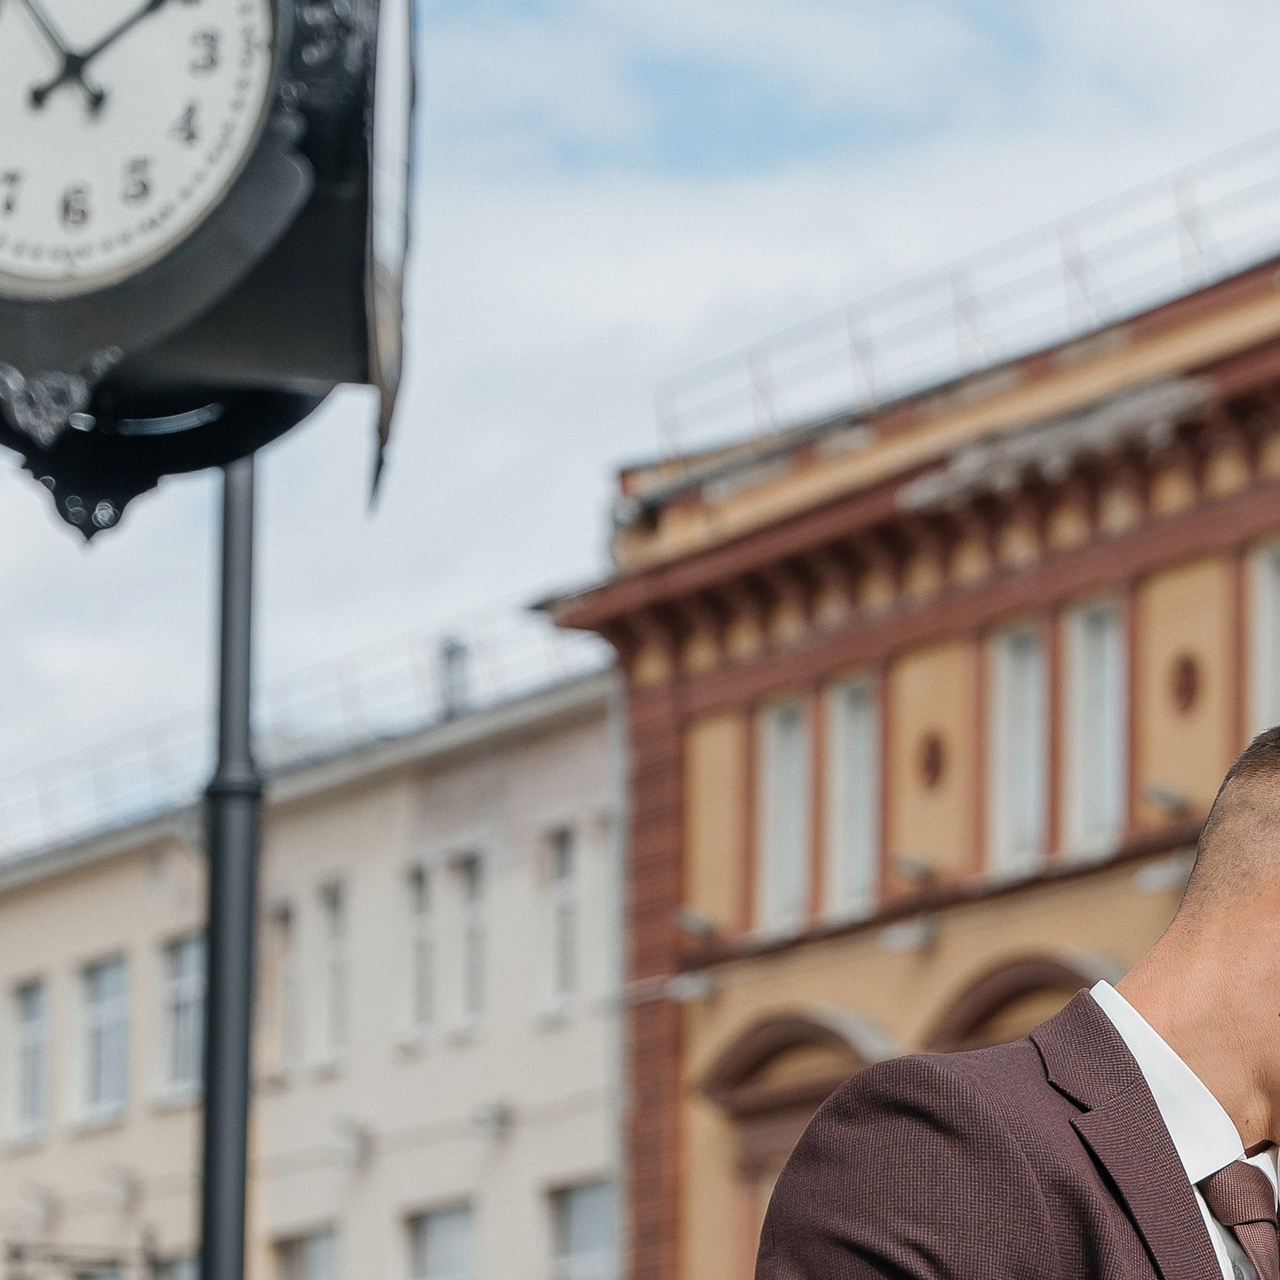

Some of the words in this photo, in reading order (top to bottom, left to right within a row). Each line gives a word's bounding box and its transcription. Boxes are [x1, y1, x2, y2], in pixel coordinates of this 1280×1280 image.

[188, 29, 220, 76] 3
[169, 101, 199, 146] 4
[123, 156, 152, 203] 5
[60, 183, 91, 230] 6
